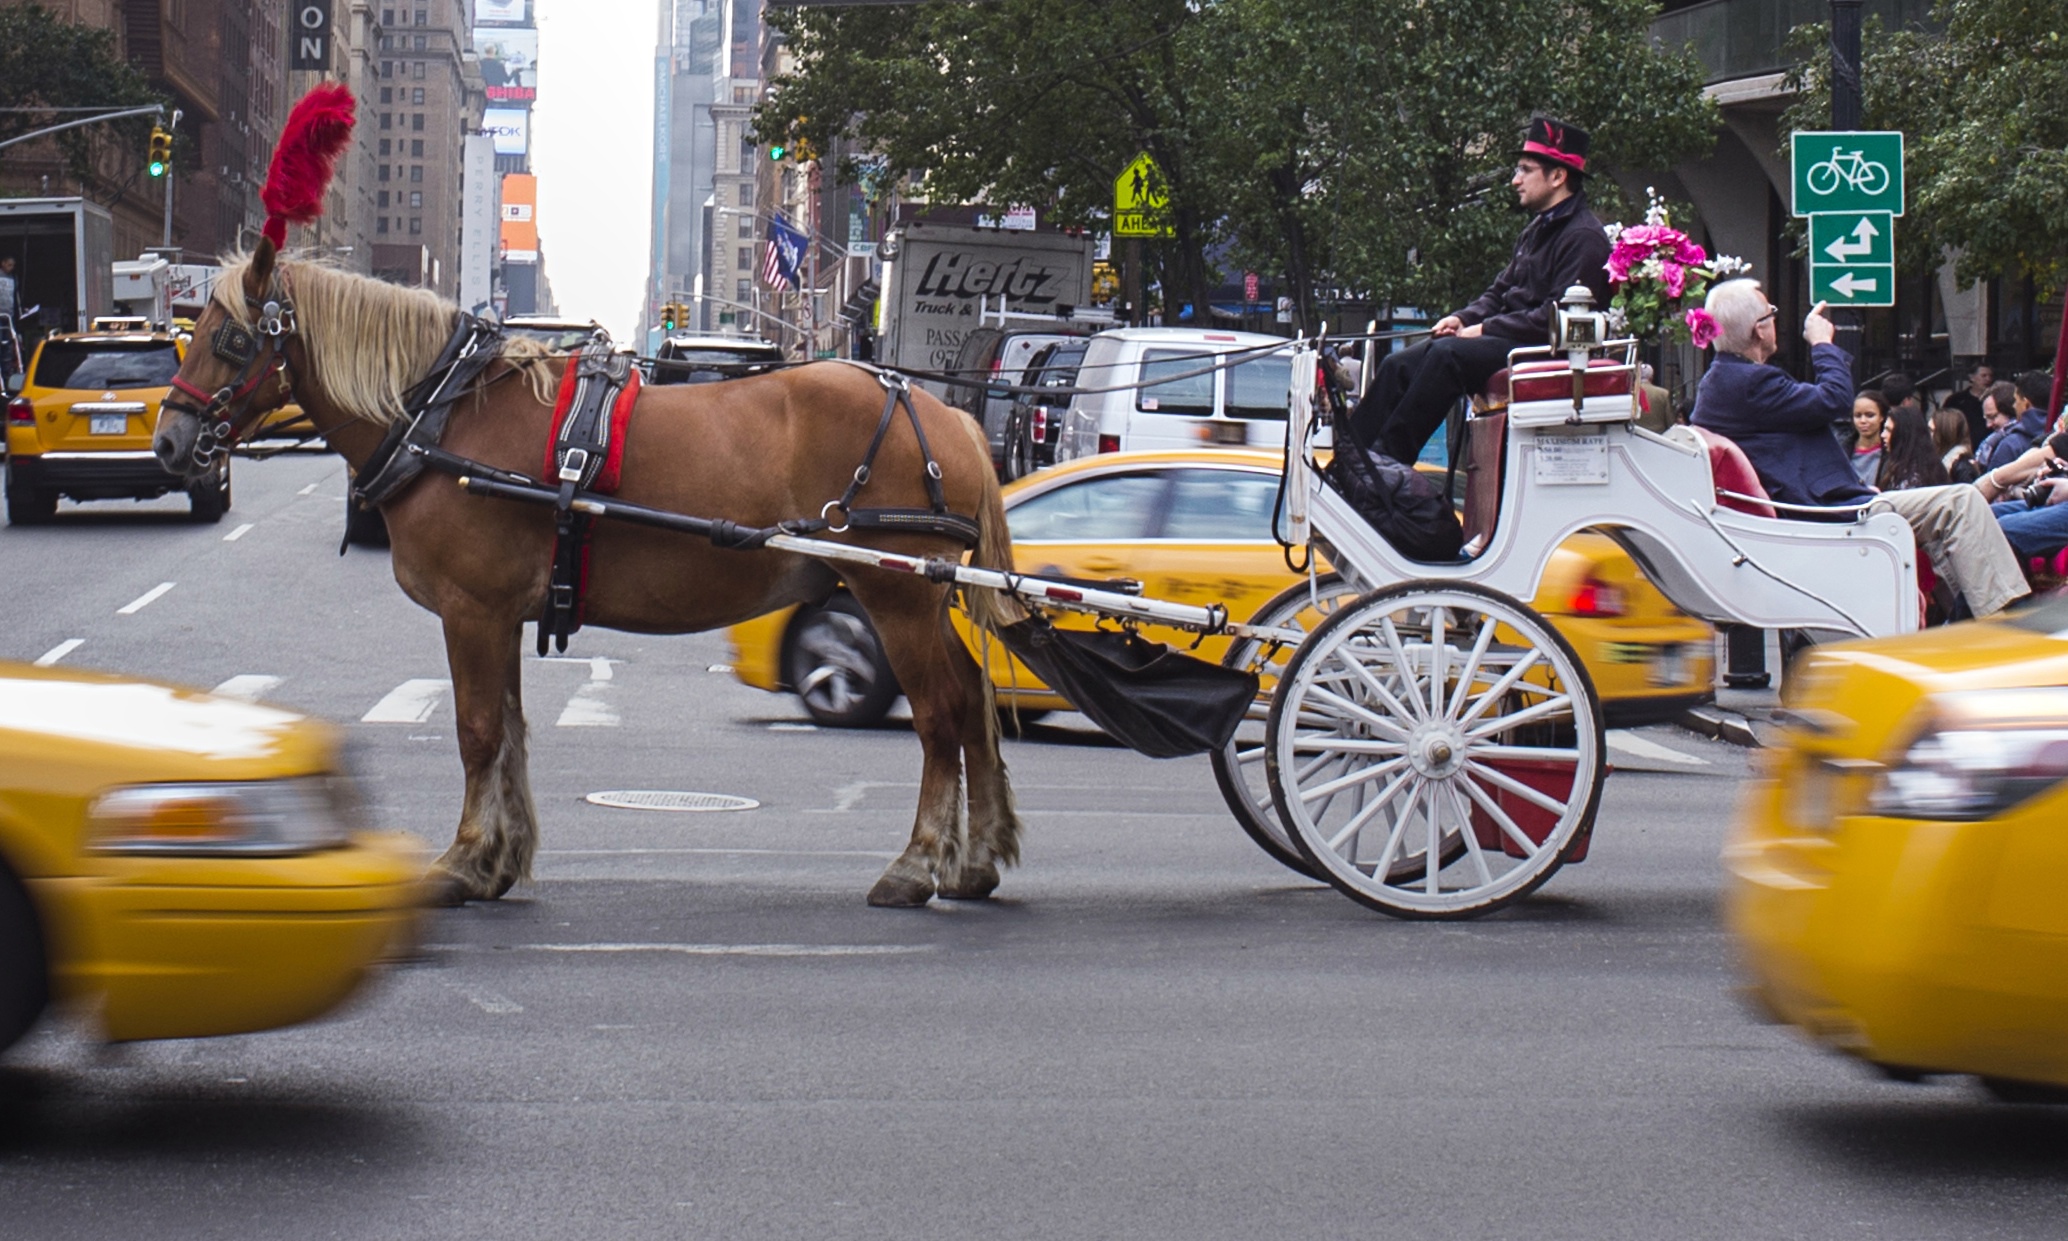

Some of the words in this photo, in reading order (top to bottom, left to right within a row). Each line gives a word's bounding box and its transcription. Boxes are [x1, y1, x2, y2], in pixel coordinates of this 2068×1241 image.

[474, 156, 484, 217] PERRY
[472, 229, 482, 286] ELLIS
[915, 252, 1071, 304] Hertz
[915, 301, 955, 315] Truck
[959, 303, 973, 316] &
